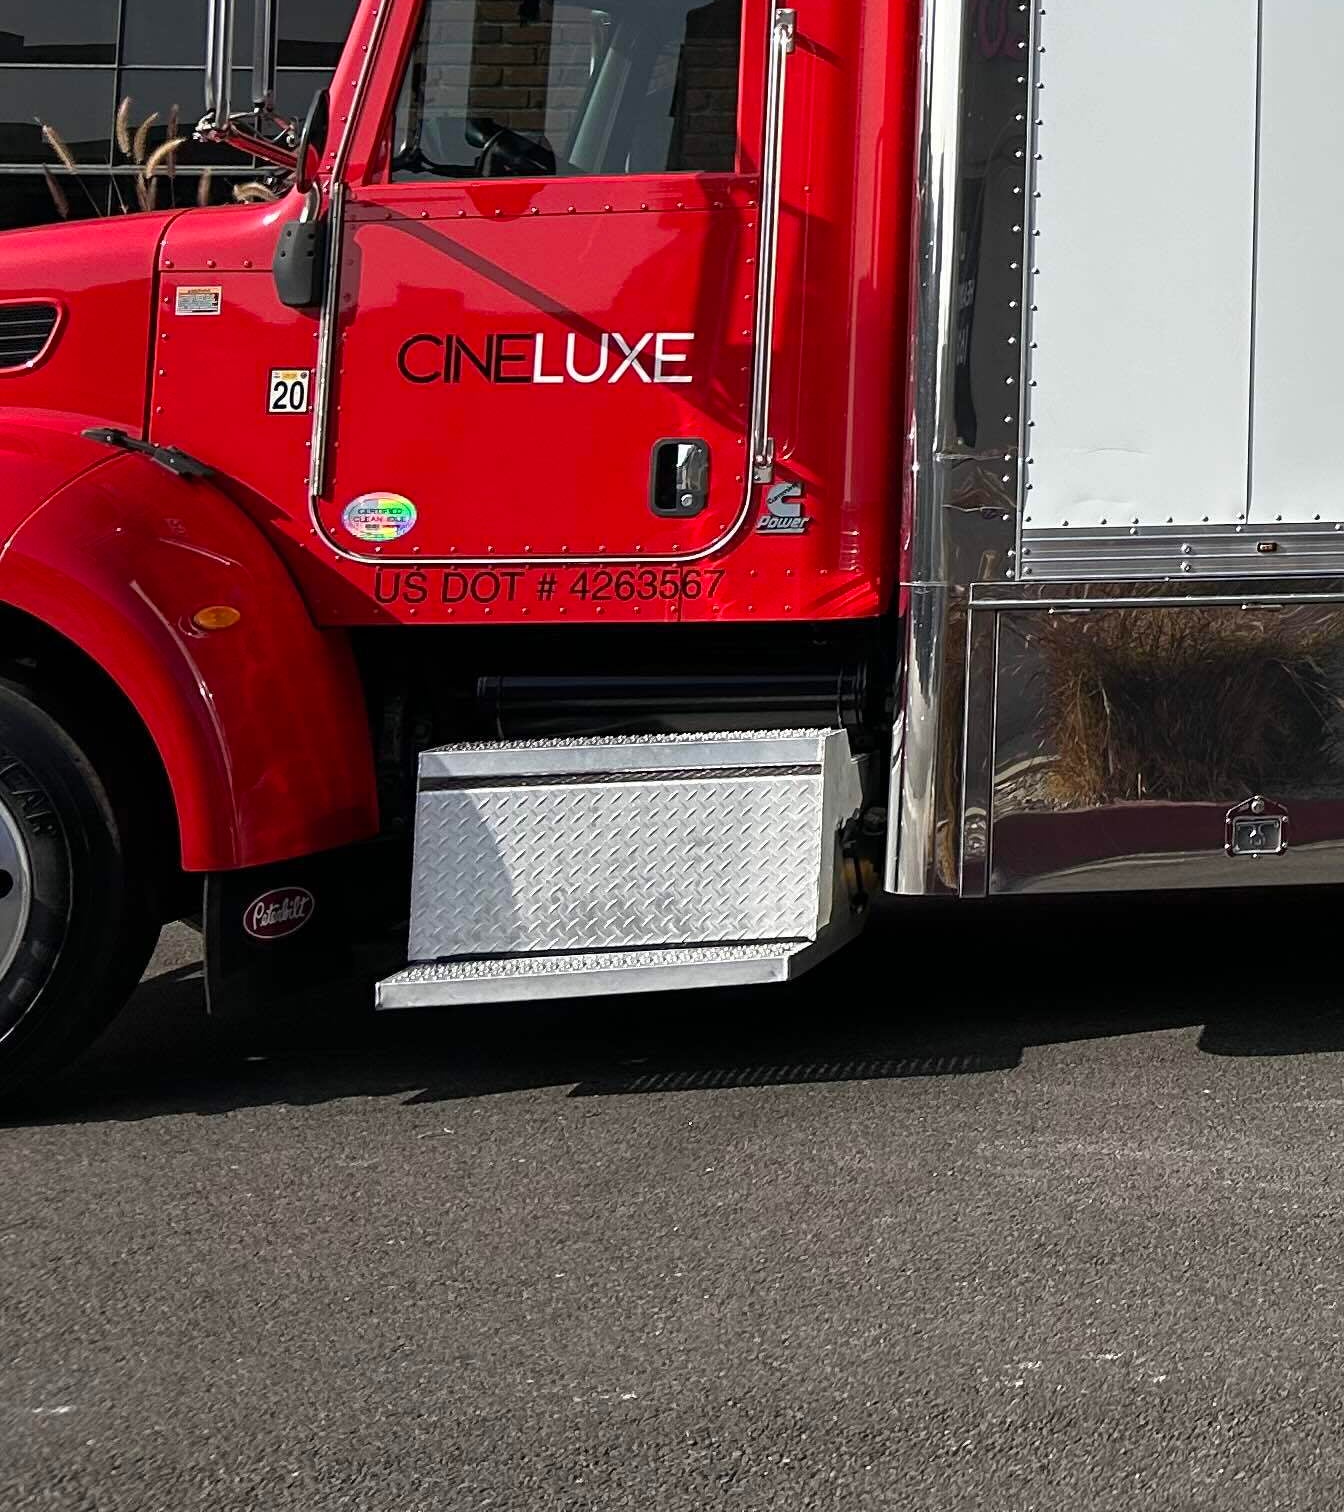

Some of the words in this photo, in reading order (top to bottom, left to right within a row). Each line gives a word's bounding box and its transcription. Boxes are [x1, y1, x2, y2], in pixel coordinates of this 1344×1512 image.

[397, 332, 695, 384] CINELUXE
[272, 380, 305, 410] 20
[756, 516, 810, 529] Power
[374, 569, 428, 604] US
[441, 569, 525, 604] DOT
[536, 571, 557, 601] #
[569, 568, 726, 602] 4263567
[252, 895, 310, 931] Peterbilt
